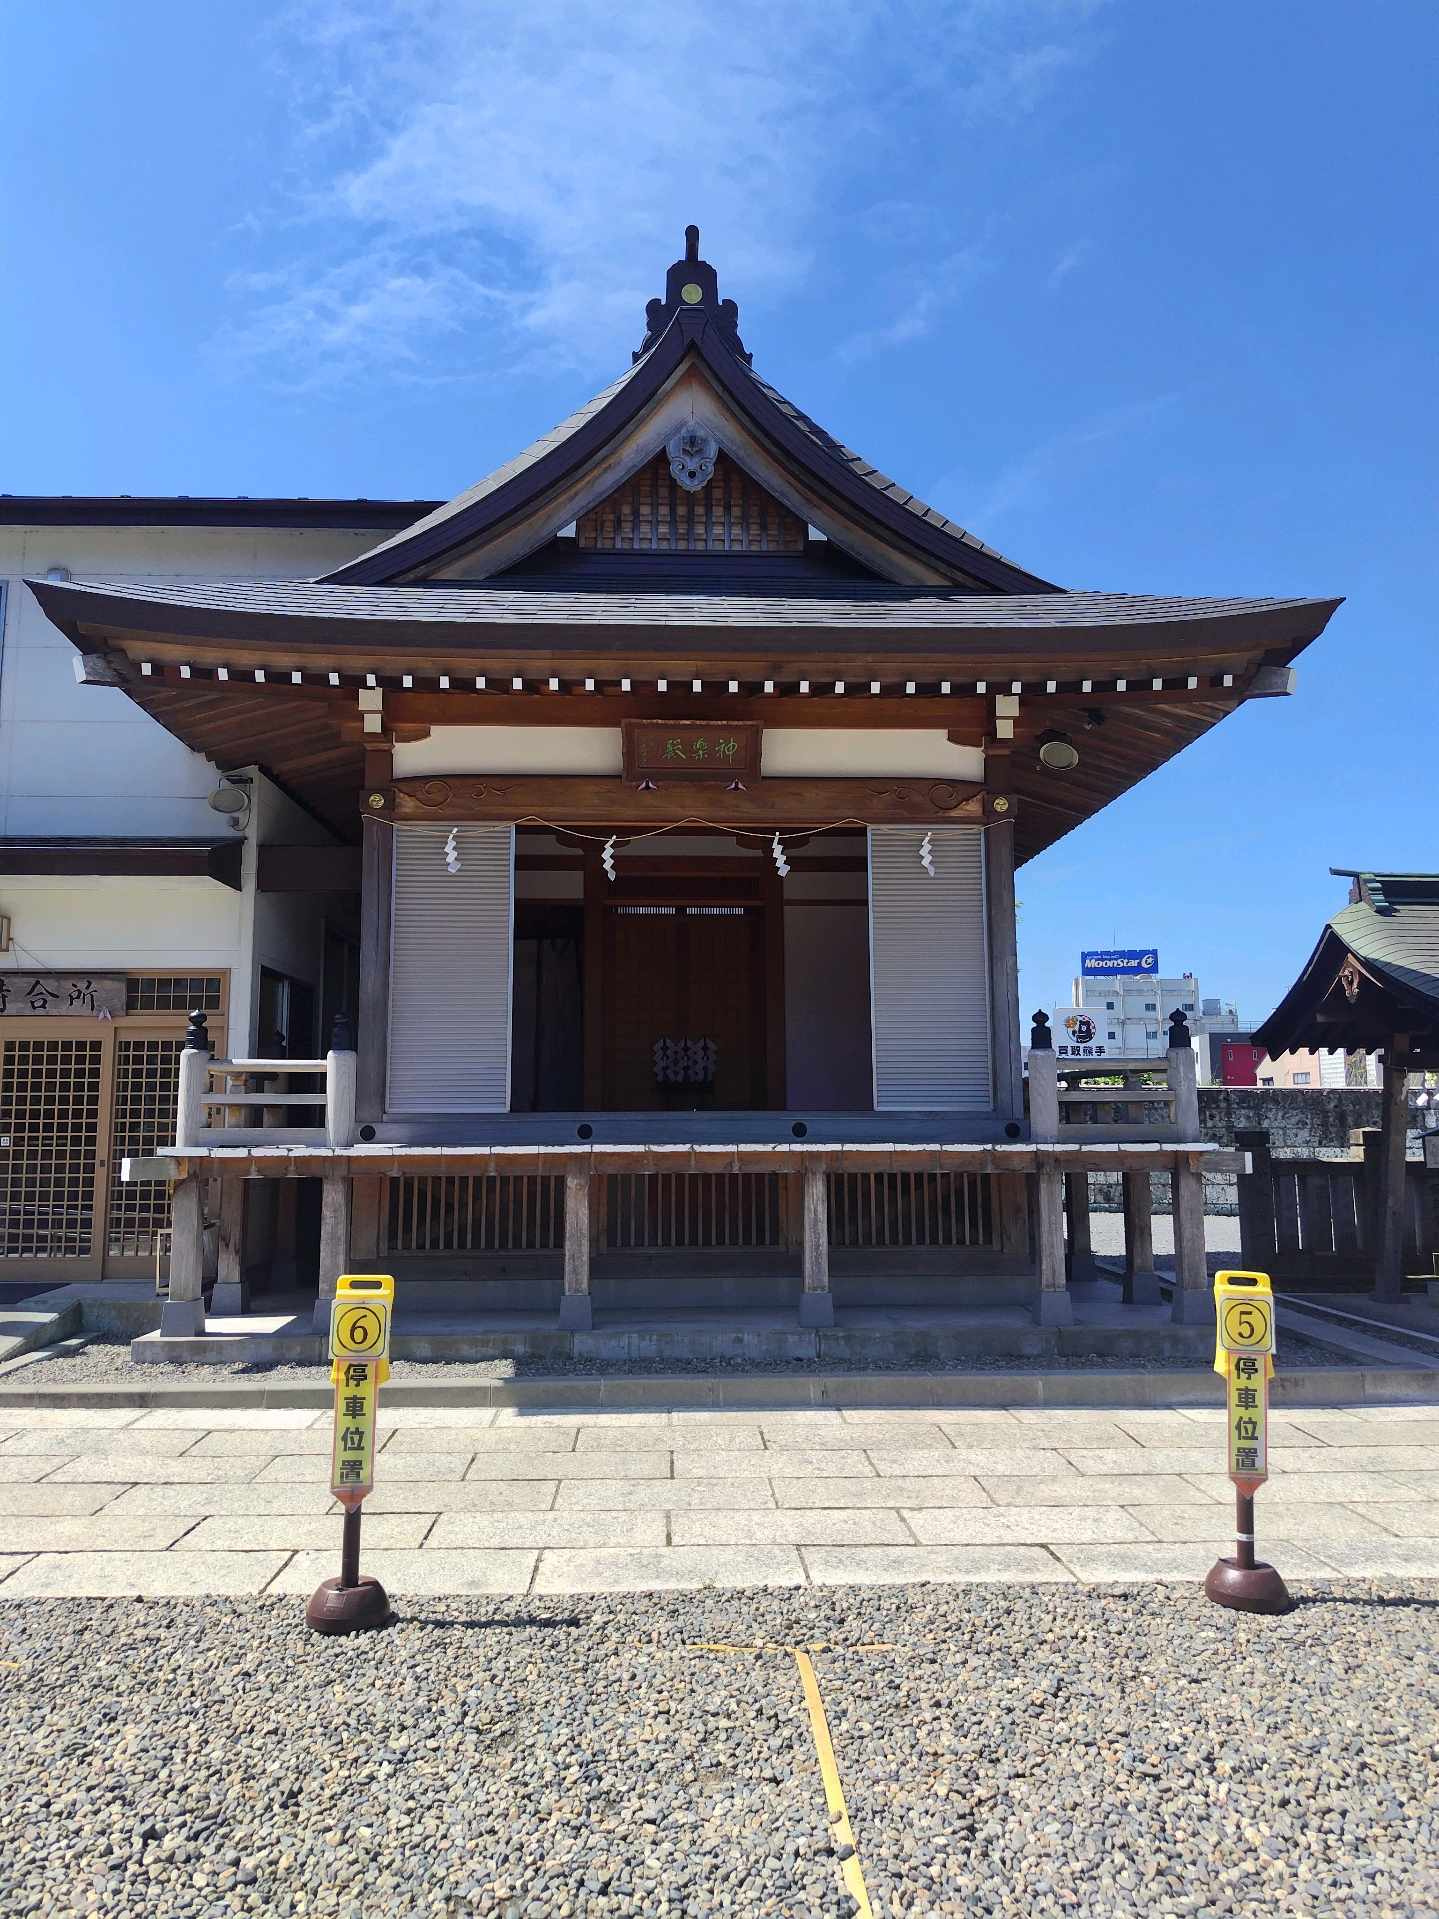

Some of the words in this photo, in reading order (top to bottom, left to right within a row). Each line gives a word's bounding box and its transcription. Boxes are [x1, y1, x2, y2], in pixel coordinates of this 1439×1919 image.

[1085, 958, 1140, 968] MoonStar
[1058, 1045, 1105, 1056] 買取熊手
[349, 1314, 368, 1344] 6
[1237, 1310, 1255, 1339] 5
[339, 1362, 368, 1484] 停車位置
[1234, 1356, 1258, 1472] 停車位置
